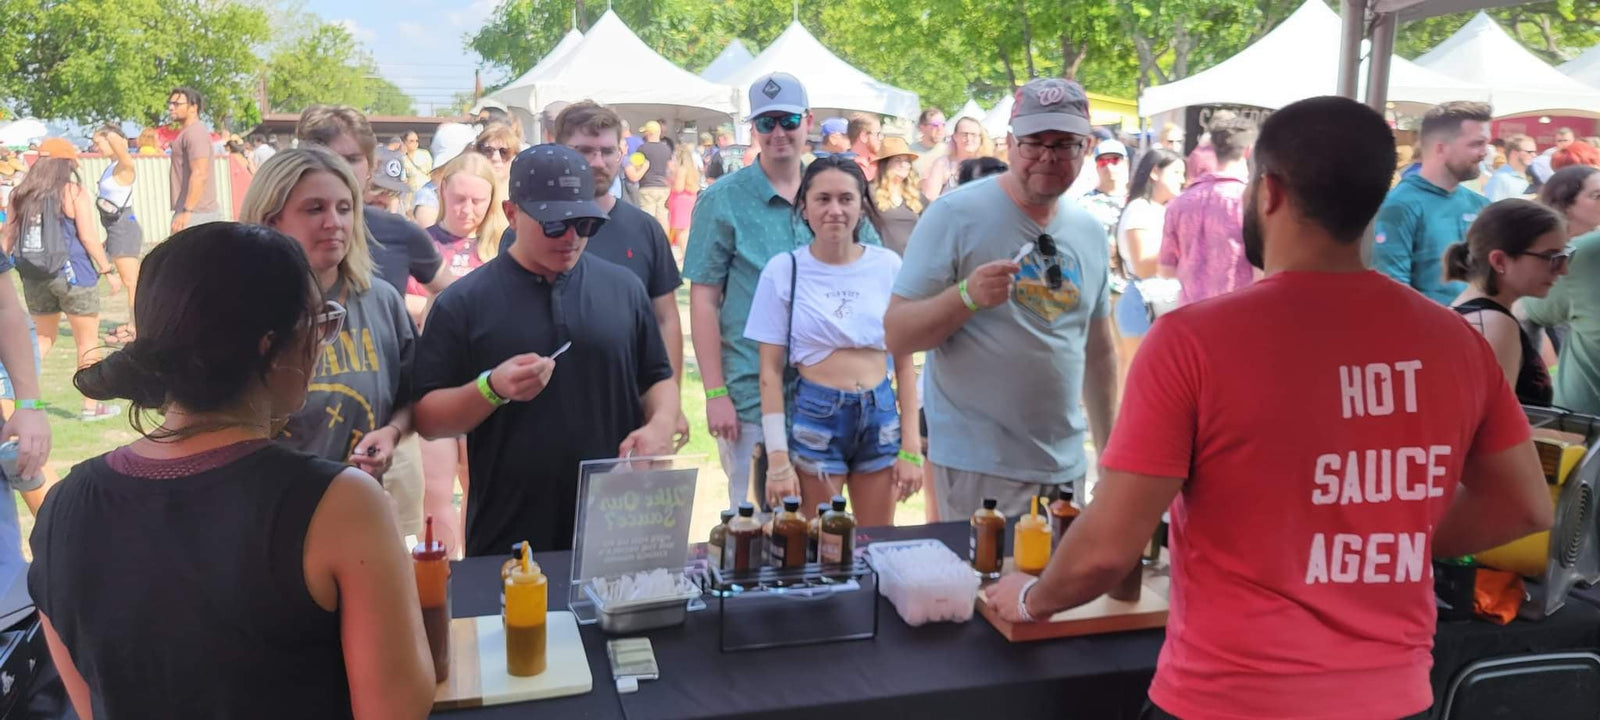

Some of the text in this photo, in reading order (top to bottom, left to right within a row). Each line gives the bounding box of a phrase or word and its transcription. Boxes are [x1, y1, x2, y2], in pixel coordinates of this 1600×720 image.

[1037, 86, 1065, 105] W
[1339, 360, 1423, 418] HOT
[1312, 445, 1452, 505] SAUCE
[1305, 532, 1434, 584] AGEN
